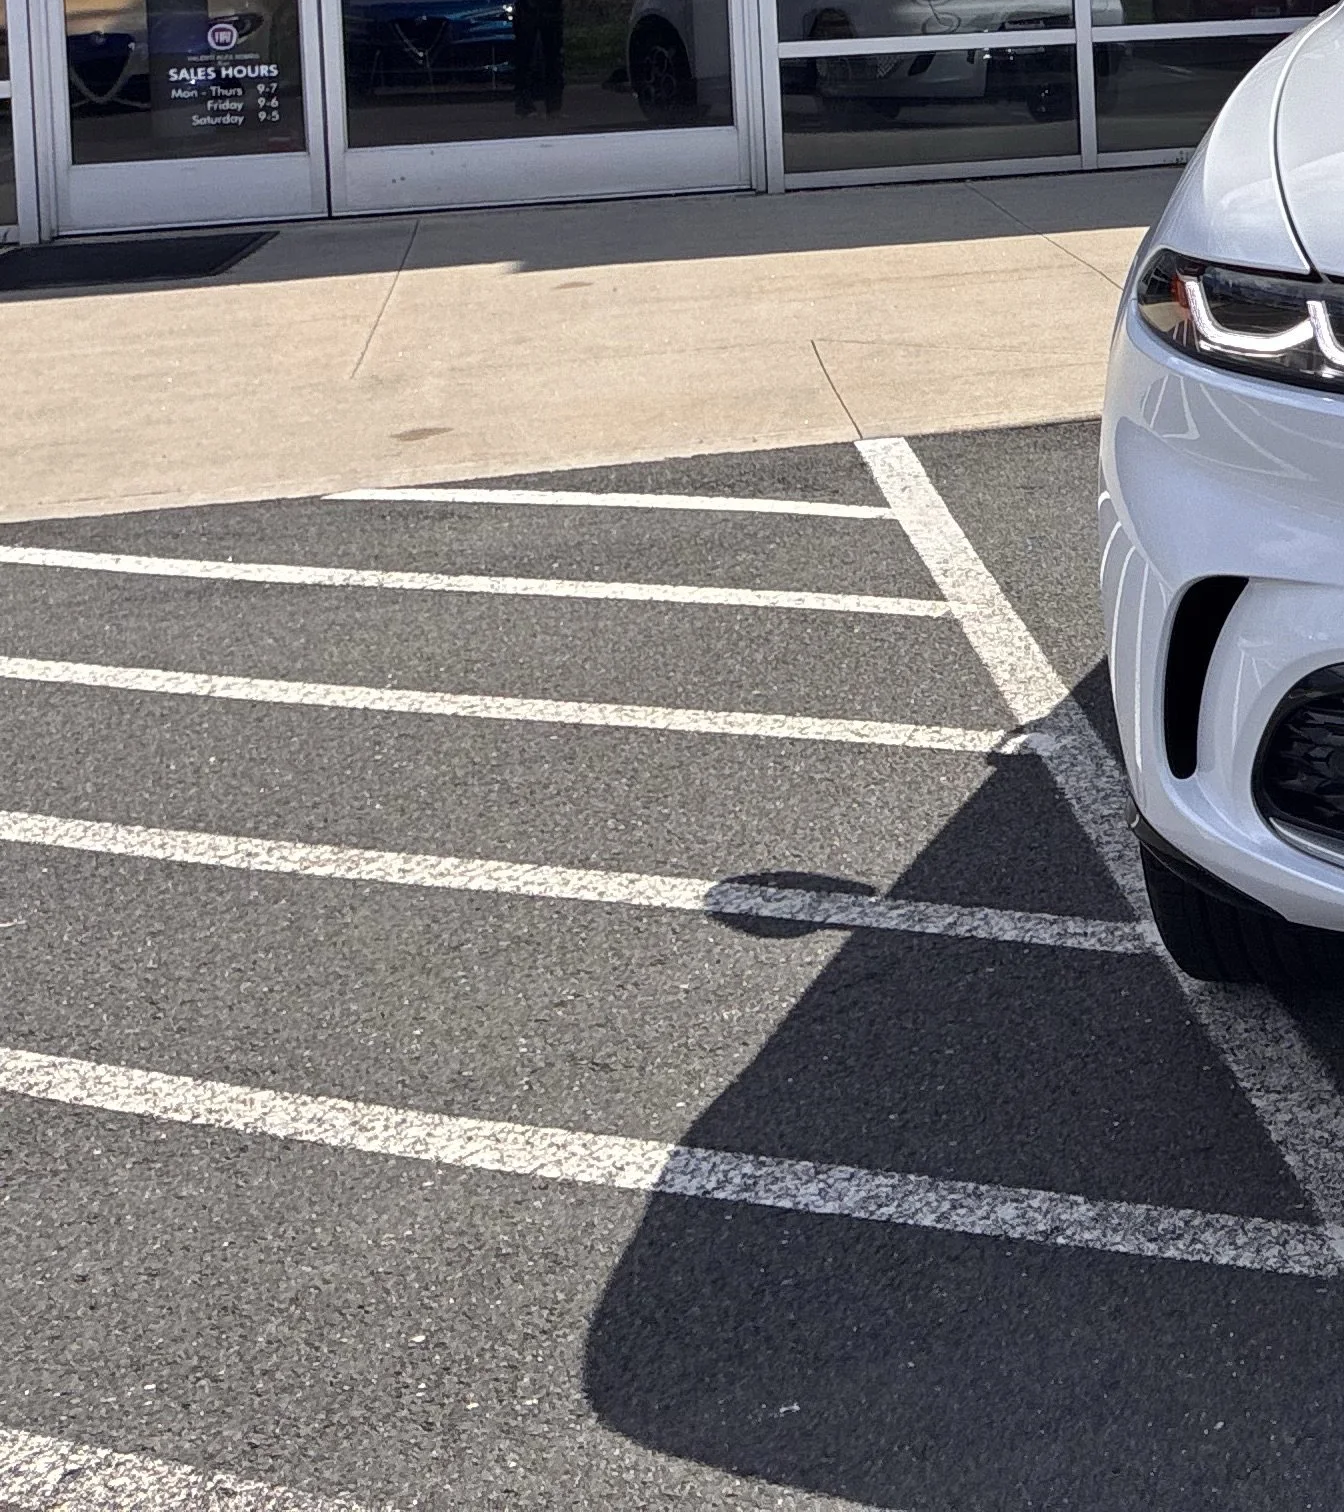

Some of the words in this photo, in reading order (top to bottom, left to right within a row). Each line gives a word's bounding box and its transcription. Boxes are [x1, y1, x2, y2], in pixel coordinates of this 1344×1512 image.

[169, 67, 216, 81] SALES
[221, 64, 278, 78] HOURS
[171, 89, 198, 99] Mon
[210, 86, 243, 97] Thurs
[207, 100, 244, 111] Friday
[192, 112, 245, 126] Saturday
